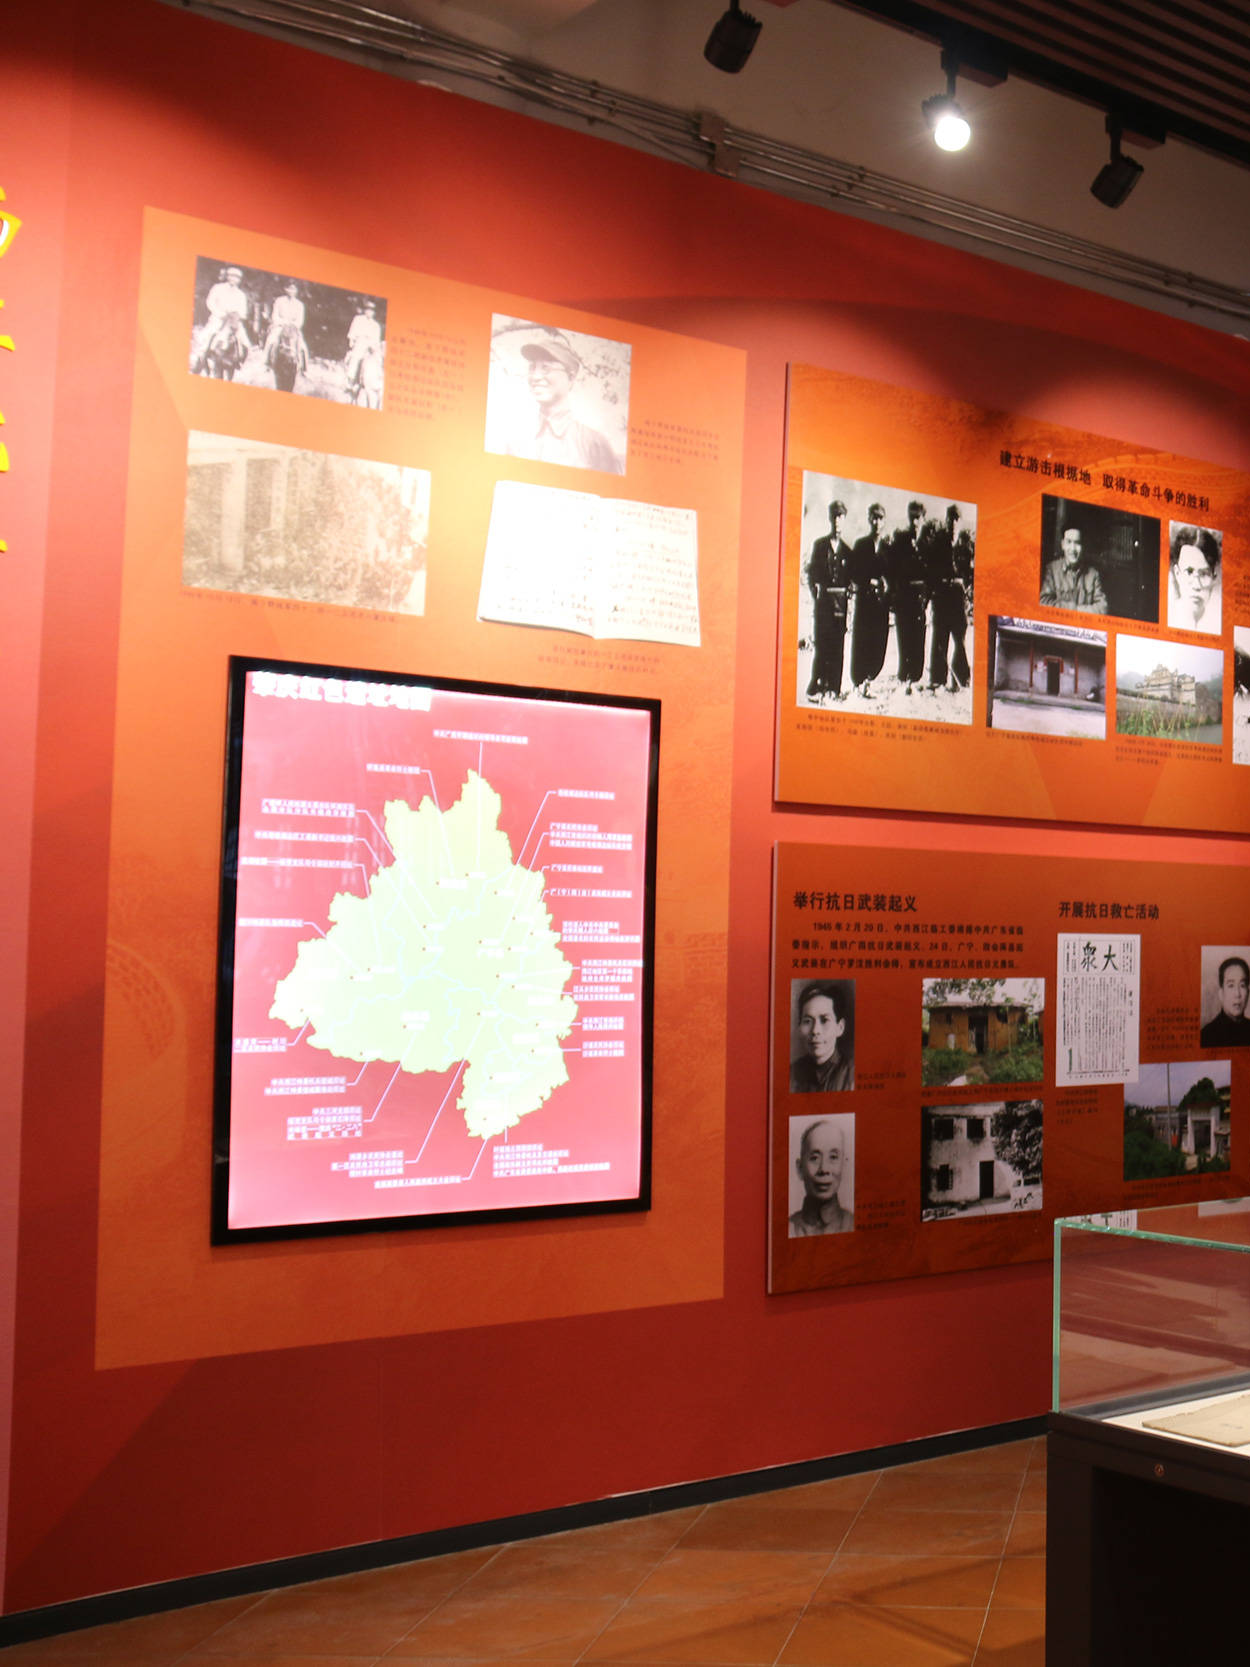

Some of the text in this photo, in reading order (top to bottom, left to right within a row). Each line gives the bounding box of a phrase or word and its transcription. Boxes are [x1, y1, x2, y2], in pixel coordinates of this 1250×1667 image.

[1000, 449, 1210, 512] 建立游击根据地 取得革命斗争的胜利
[793, 891, 918, 913] 举行抗日武装起义
[1058, 901, 1159, 921] 开展抗日救亡活动
